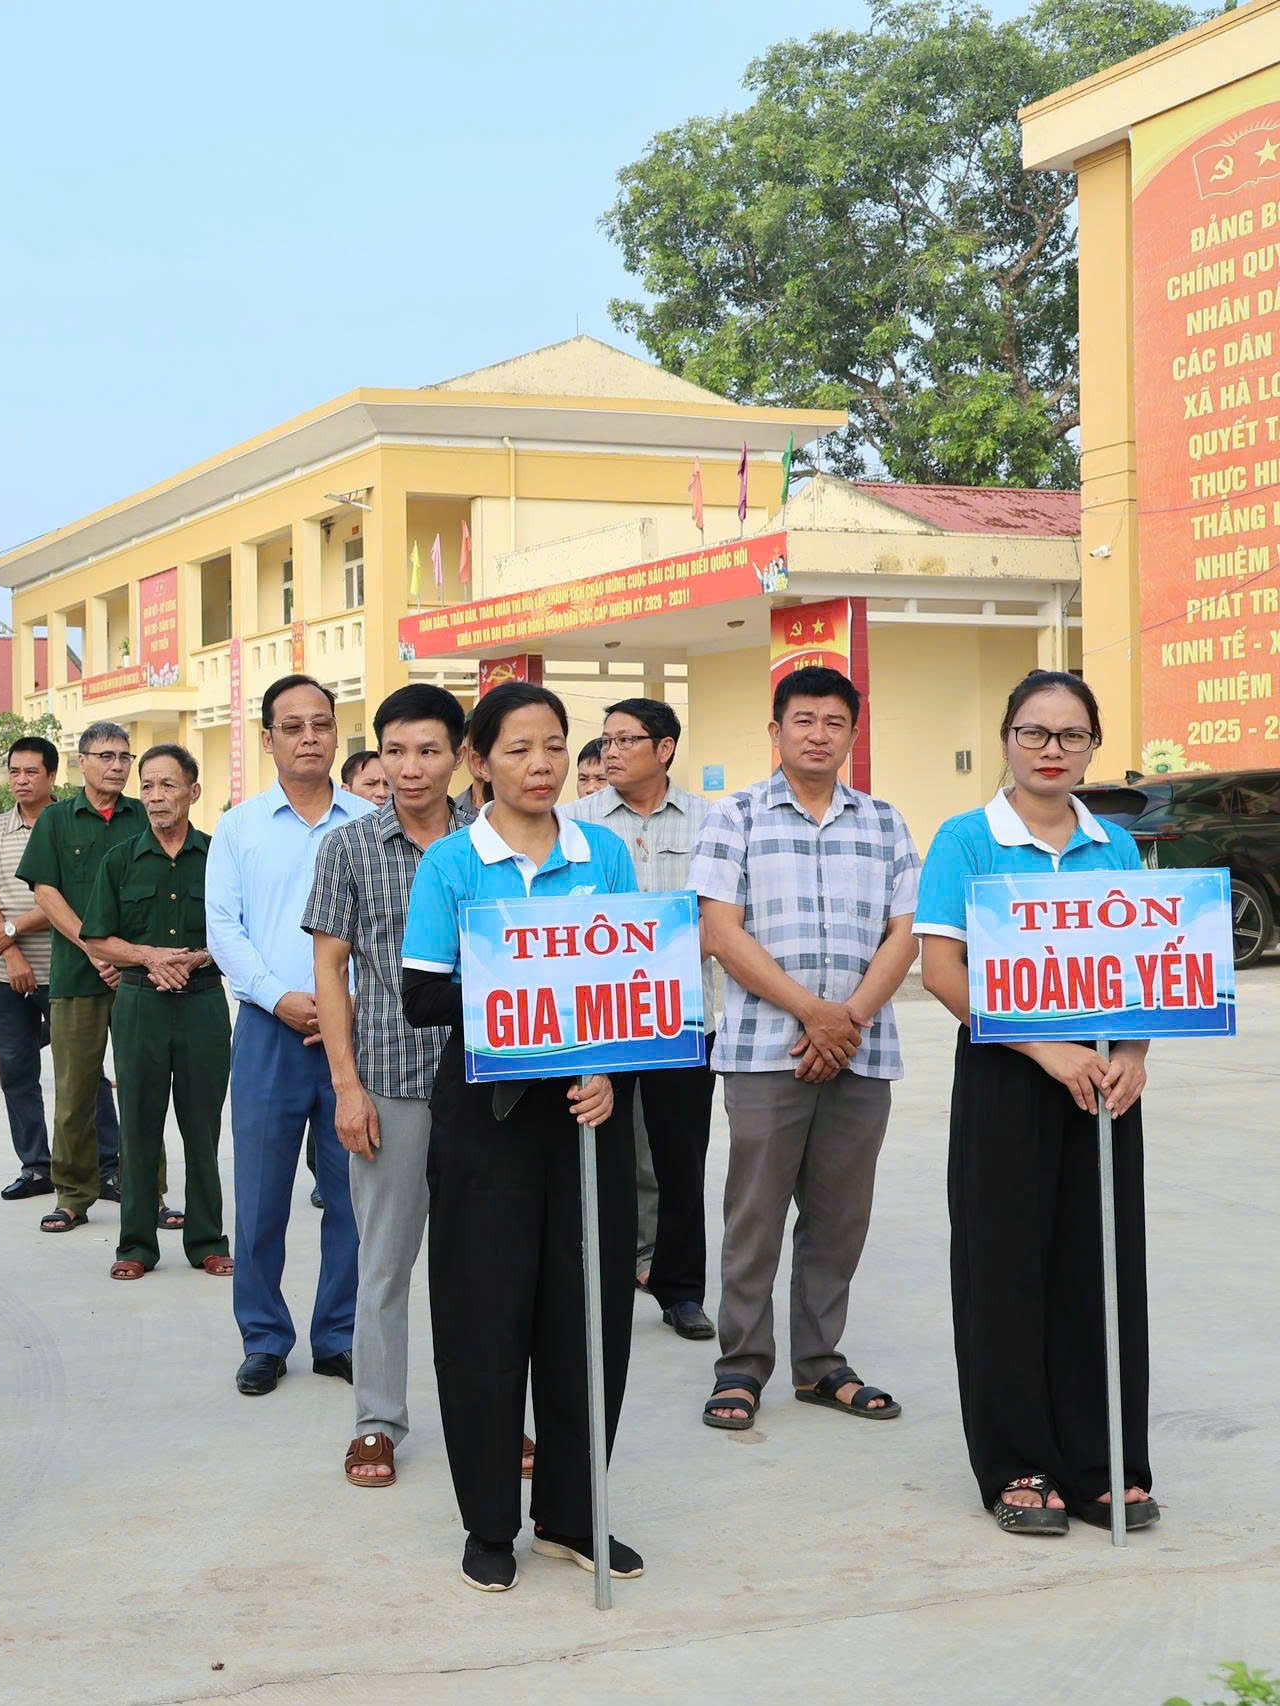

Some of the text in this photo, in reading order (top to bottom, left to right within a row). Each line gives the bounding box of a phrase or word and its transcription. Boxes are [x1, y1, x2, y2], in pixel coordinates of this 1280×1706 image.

[1190, 201, 1280, 253] ĐẢNG B
[1166, 257, 1235, 301] CHÍNH
[1186, 295, 1250, 336] NHÂN
[1172, 331, 1272, 381] CÁC DÂN
[1183, 385, 1214, 420] XÃ
[1220, 376, 1252, 410] HÀ
[1188, 415, 1259, 461] QUYẾT
[1189, 465, 1247, 501] THỰC
[1190, 501, 1266, 540] THẮNG
[627, 569, 647, 589] CUỘC
[648, 564, 663, 585] BẦU
[664, 560, 675, 581] CỬ
[676, 561, 690, 581] ĐẠI
[690, 552, 709, 576] BIỂU
[710, 547, 732, 573] QUỐC
[733, 546, 748, 568] HỘI
[1194, 545, 1270, 581] NHIỆM
[644, 593, 663, 611] 2026
[1186, 589, 1243, 624] PHÁT
[1161, 637, 1213, 667] KINH
[1220, 625, 1247, 660] TẾ
[1197, 670, 1272, 706] NHIỆM
[1187, 718, 1241, 745] 2025
[1011, 889, 1182, 930] THÔN
[504, 914, 657, 960] THÔN
[985, 935, 1216, 1012] HOÀNG YẾN
[485, 969, 682, 1048] GIA MIÊU
